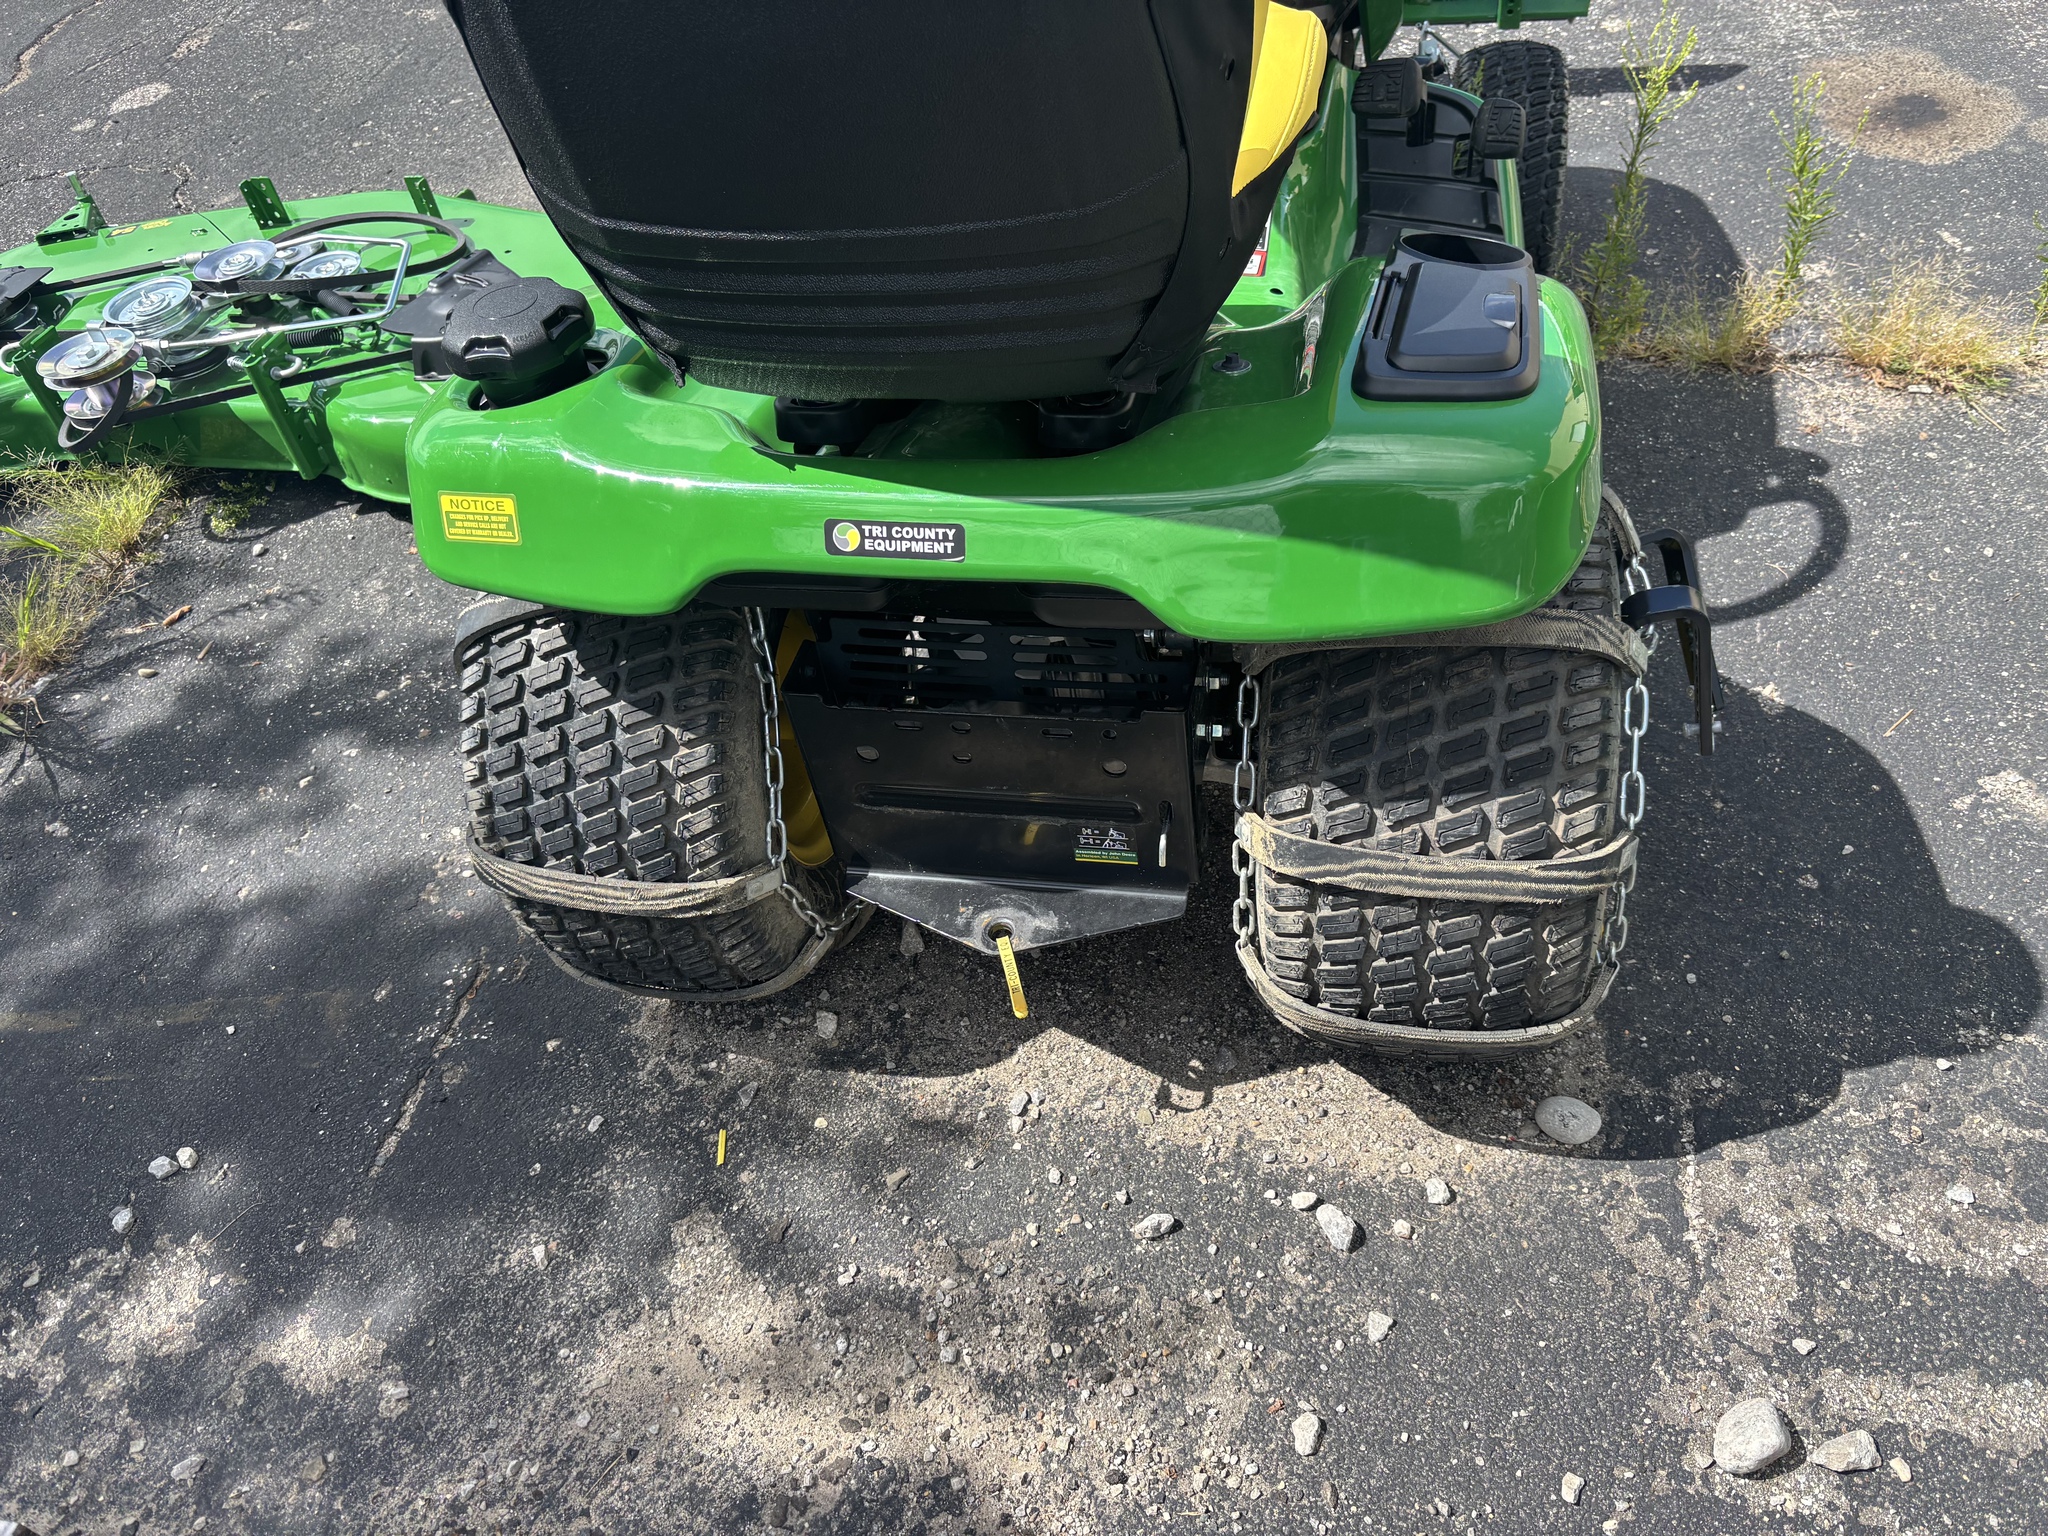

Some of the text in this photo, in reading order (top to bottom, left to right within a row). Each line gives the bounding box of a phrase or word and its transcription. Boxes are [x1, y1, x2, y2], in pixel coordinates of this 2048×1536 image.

[449, 498, 506, 512] NOTICE
[862, 525, 956, 540] TRI COUNTY
[864, 538, 955, 554] EQUIPMENT
[1003, 953, 1021, 994] TRI-COUNTY
